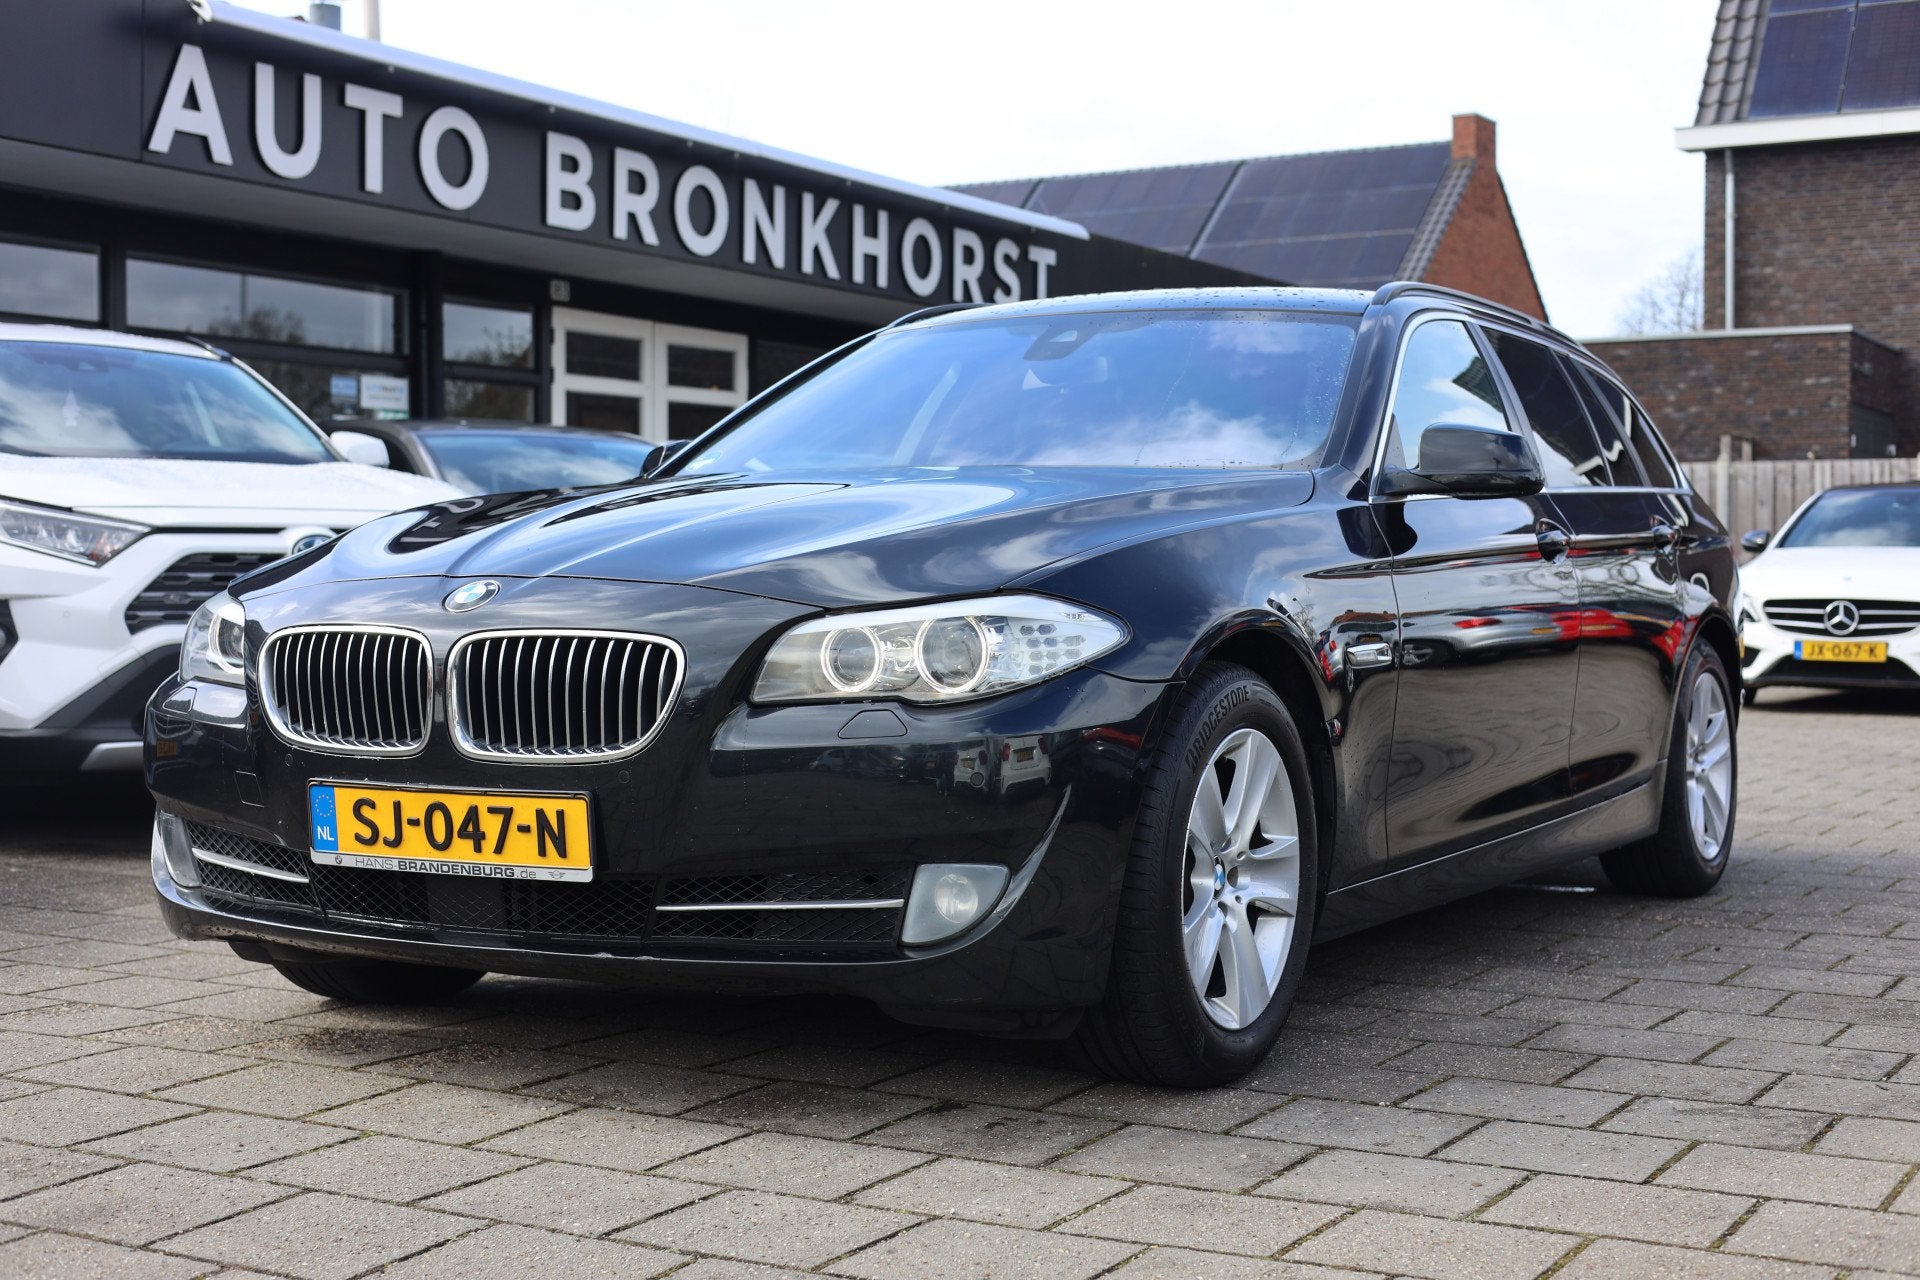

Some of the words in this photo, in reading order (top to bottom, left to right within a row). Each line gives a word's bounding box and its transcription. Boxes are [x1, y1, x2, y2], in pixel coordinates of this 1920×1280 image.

[148, 44, 489, 211] AUTO
[546, 130, 1057, 305] BRONKHORST
[1185, 685, 1250, 770] BRIDGESTONE
[317, 825, 335, 841] NL
[352, 797, 568, 859] SJ-047-N
[355, 857, 537, 880] HANS-BRANDENBURG.de
